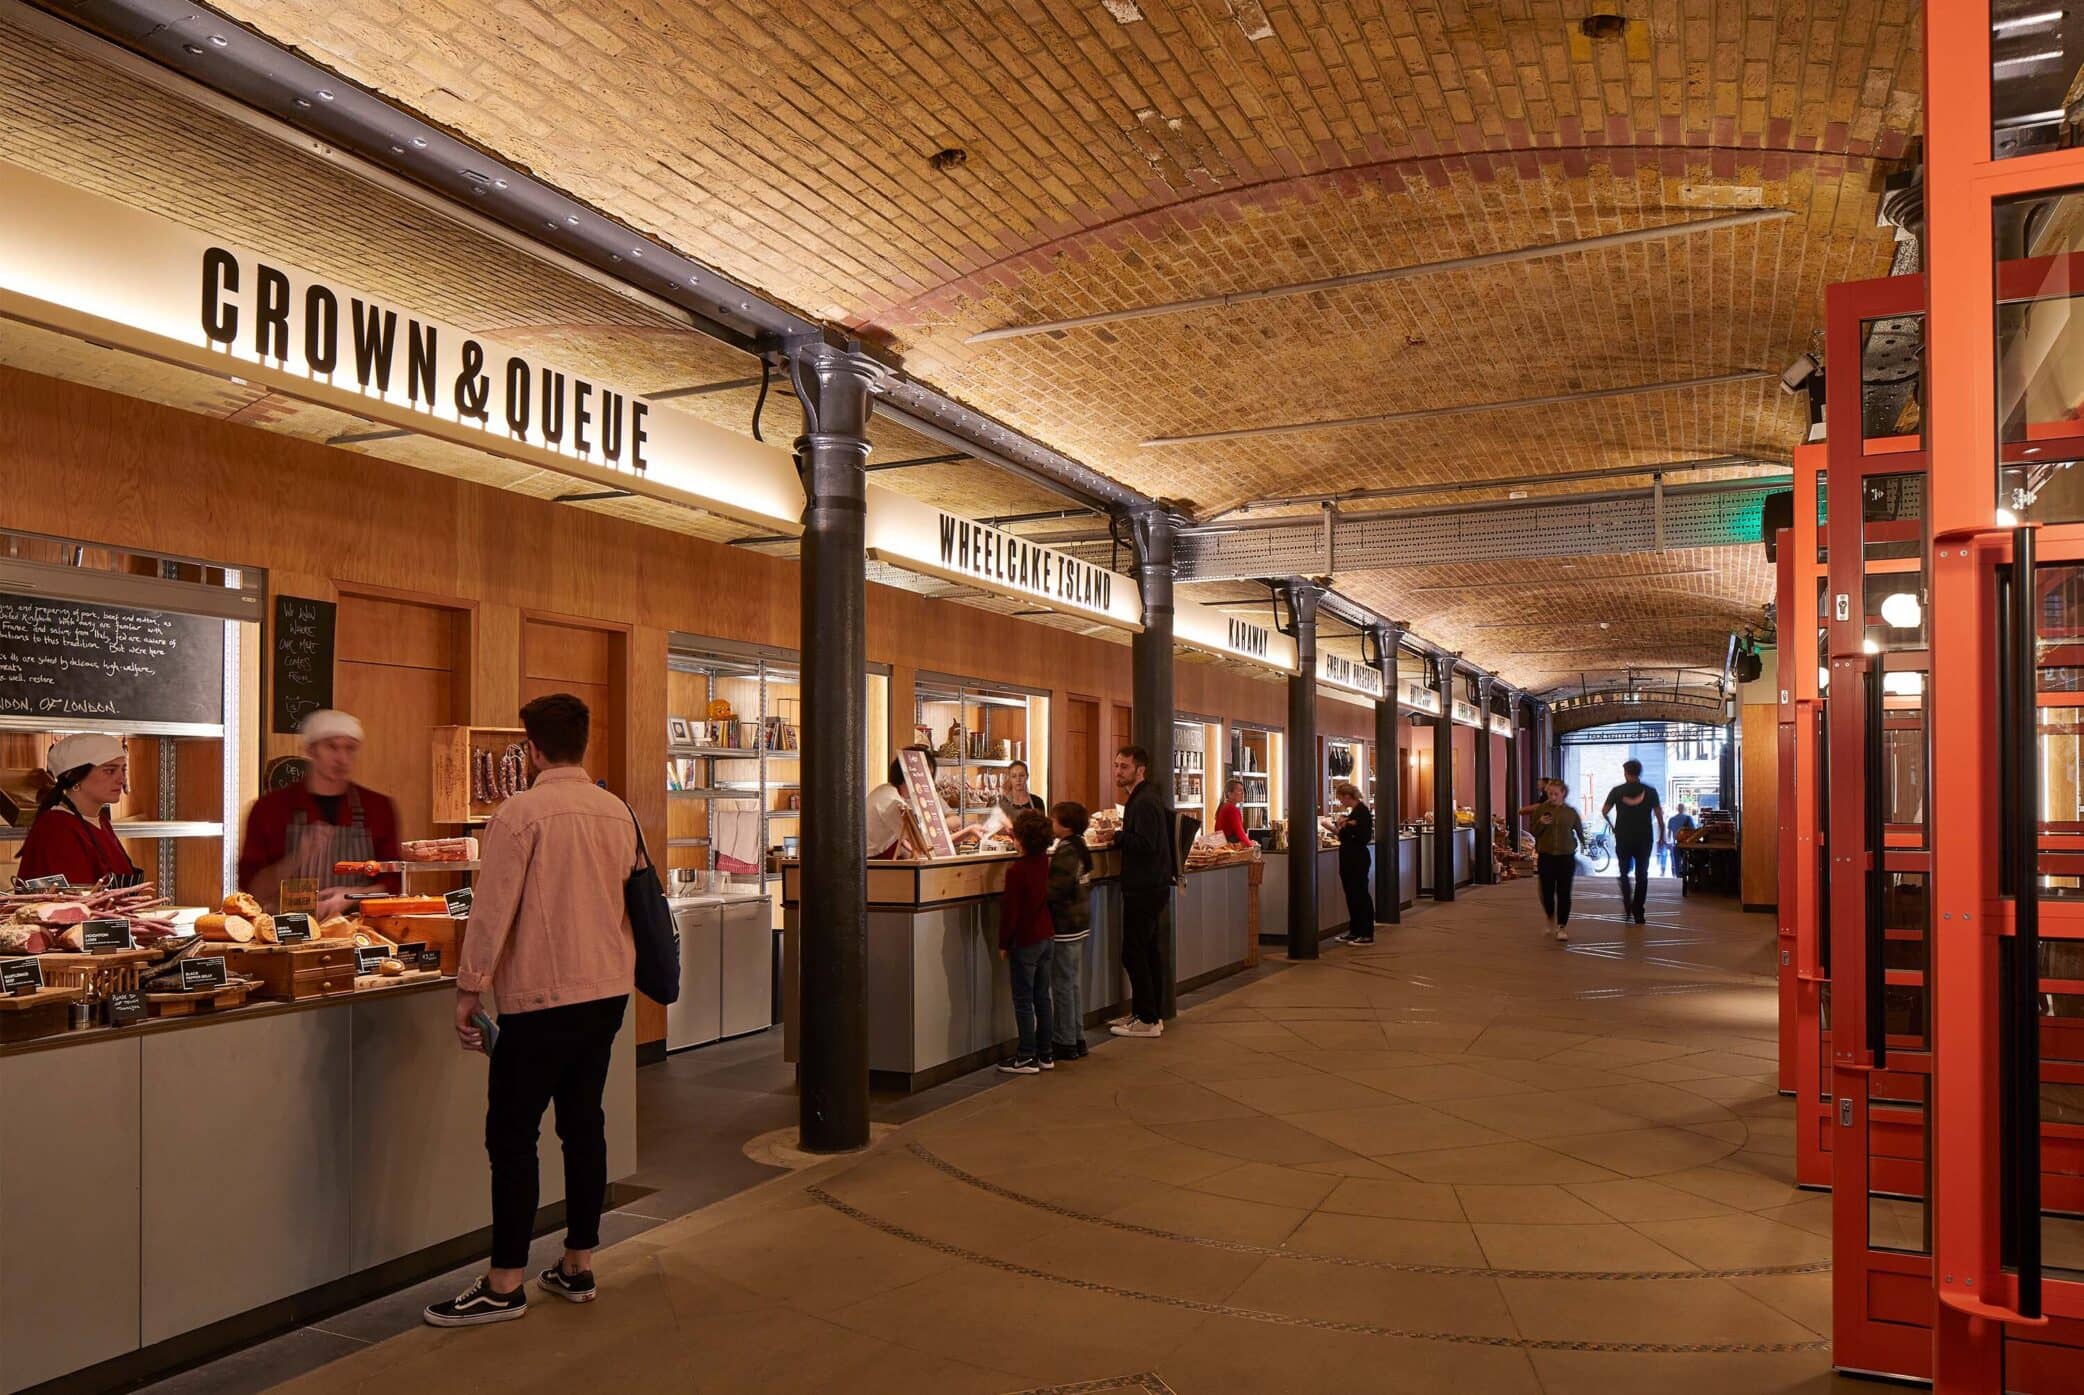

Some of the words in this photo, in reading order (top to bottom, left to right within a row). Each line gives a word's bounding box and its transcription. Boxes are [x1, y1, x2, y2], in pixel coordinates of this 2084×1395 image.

[202, 246, 438, 407] CROWN
[455, 339, 489, 422] &
[506, 356, 649, 471] QUEUE
[939, 513, 1051, 593] WHEELCAKE
[1058, 555, 1111, 610] ISLAND
[33, 632, 42, 644] to
[1228, 616, 1269, 658] KARAWAY
[39, 696, 63, 711] OF
